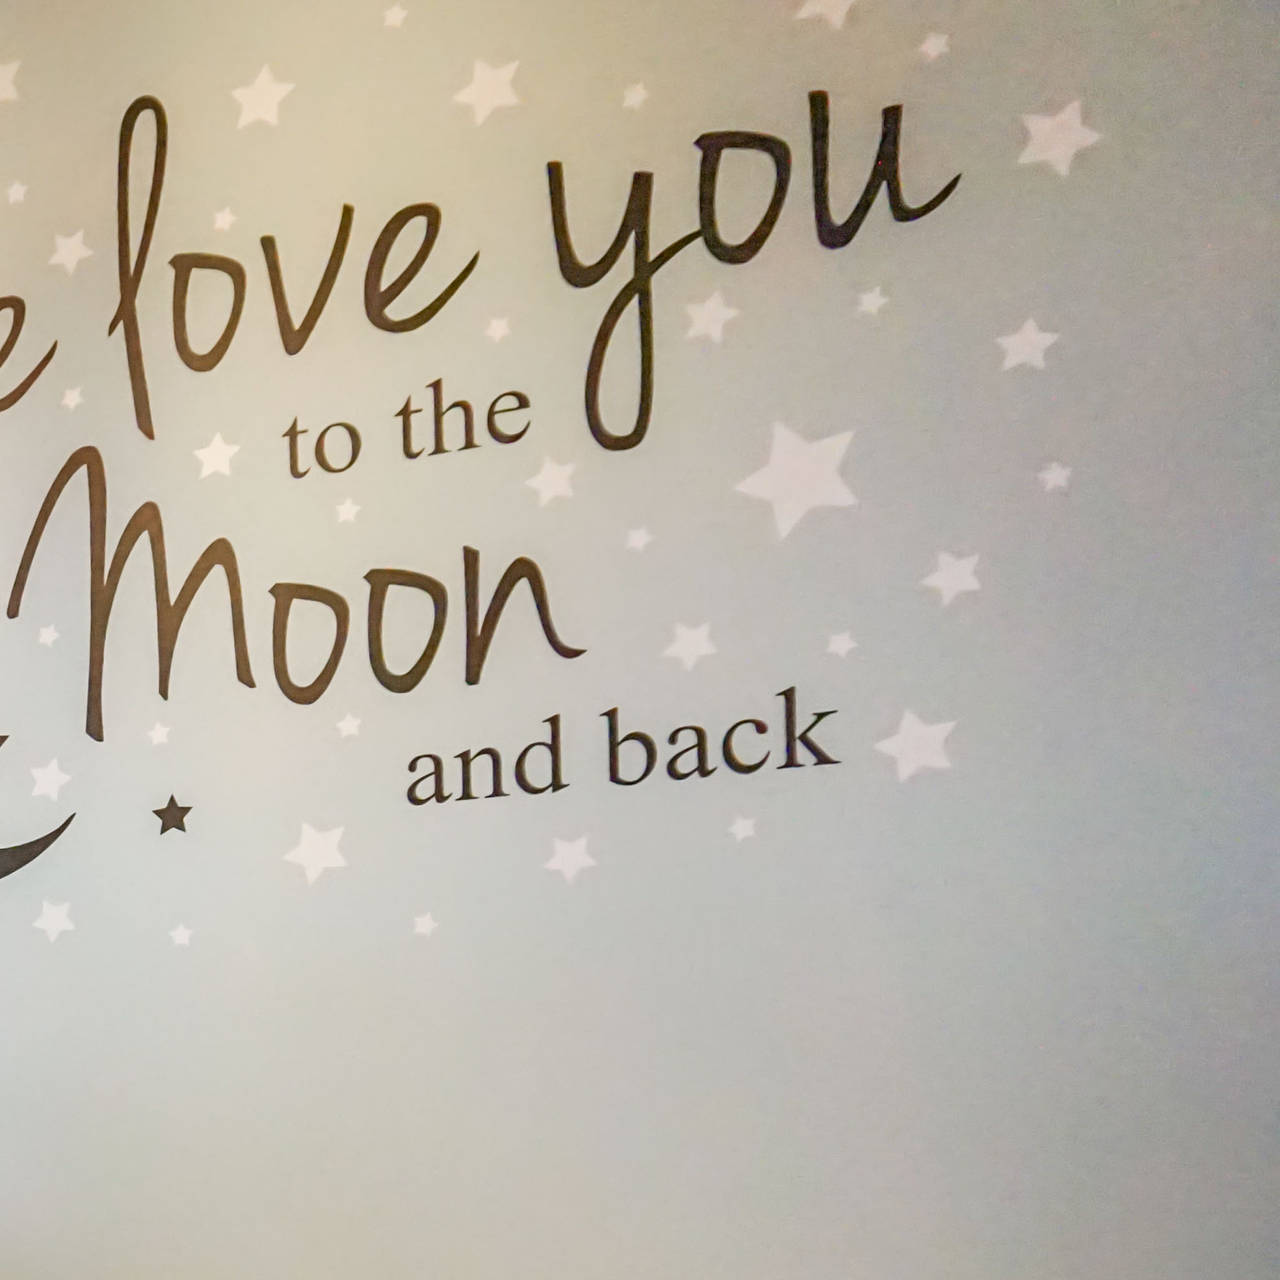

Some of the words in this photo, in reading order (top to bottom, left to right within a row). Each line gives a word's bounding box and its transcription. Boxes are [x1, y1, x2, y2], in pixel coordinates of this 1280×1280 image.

[107, 95, 480, 440] love
[545, 90, 963, 452] you
[282, 417, 362, 479] to
[394, 379, 531, 460] the
[6, 445, 588, 743] Moon
[406, 714, 571, 806] and
[599, 686, 842, 787] back
